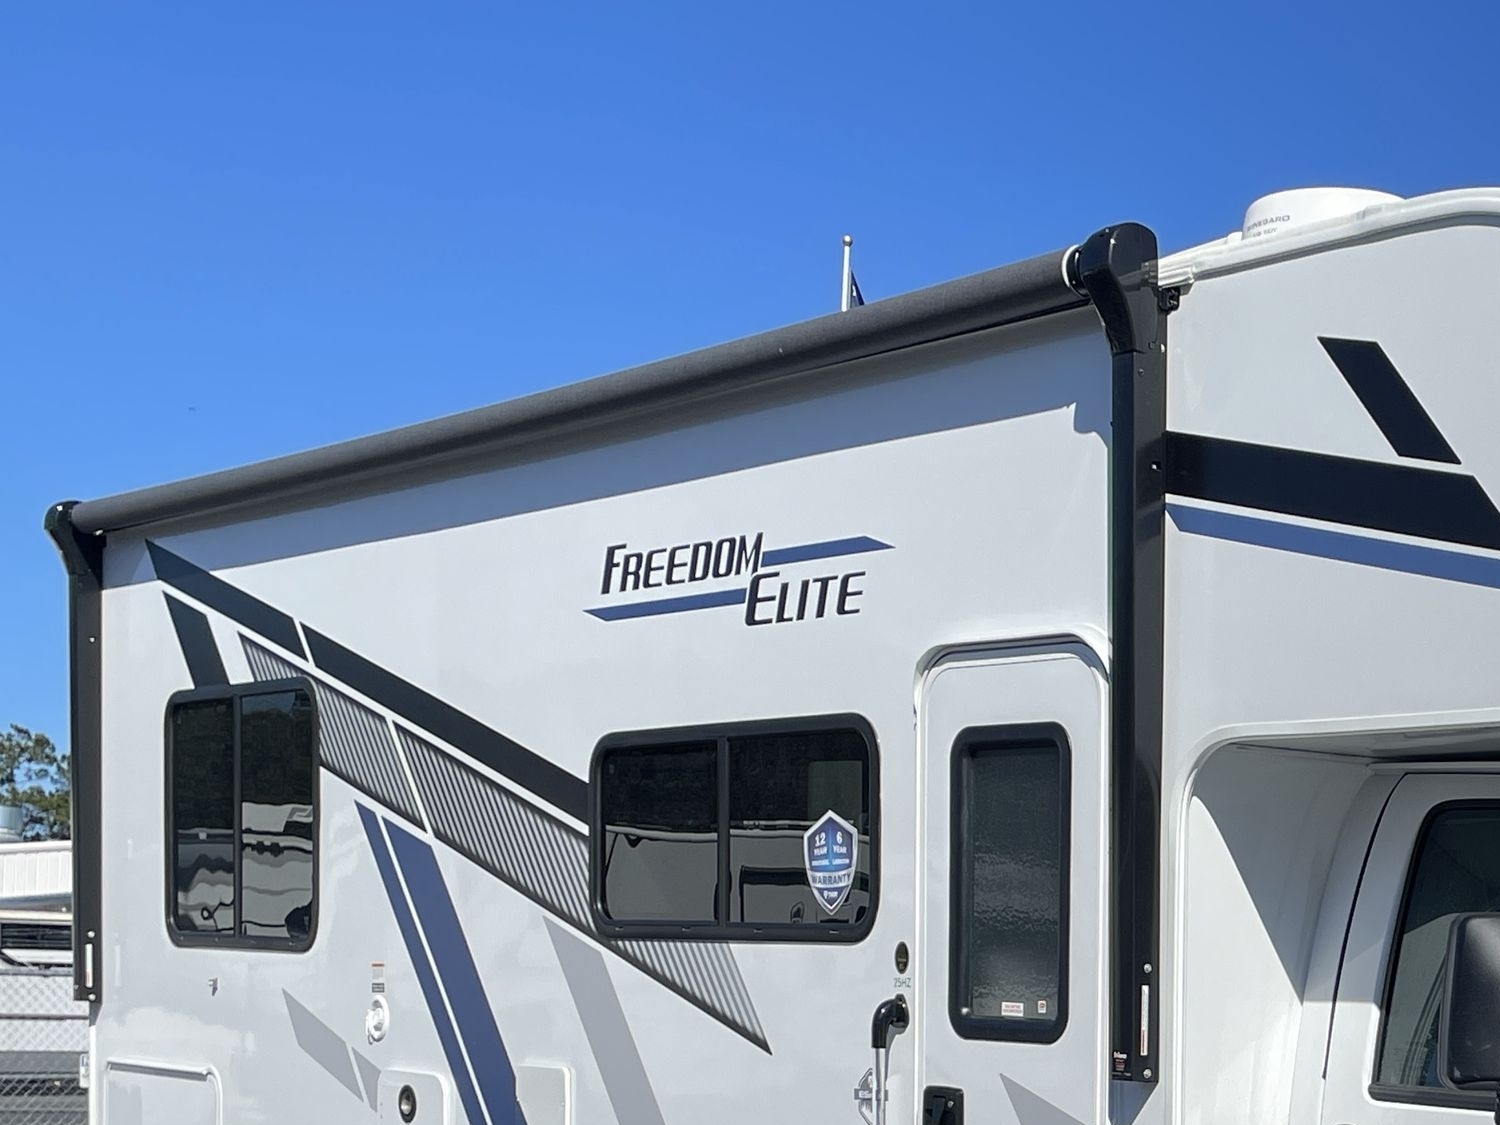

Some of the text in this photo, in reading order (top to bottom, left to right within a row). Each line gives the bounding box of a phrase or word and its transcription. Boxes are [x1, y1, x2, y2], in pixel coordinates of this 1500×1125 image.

[601, 532, 763, 595] FREEDOM
[745, 571, 866, 626] ELITE
[814, 832, 826, 847] 12
[836, 831, 843, 845] 6
[833, 844, 847, 854] YEAR
[811, 872, 852, 885] WARRANTY
